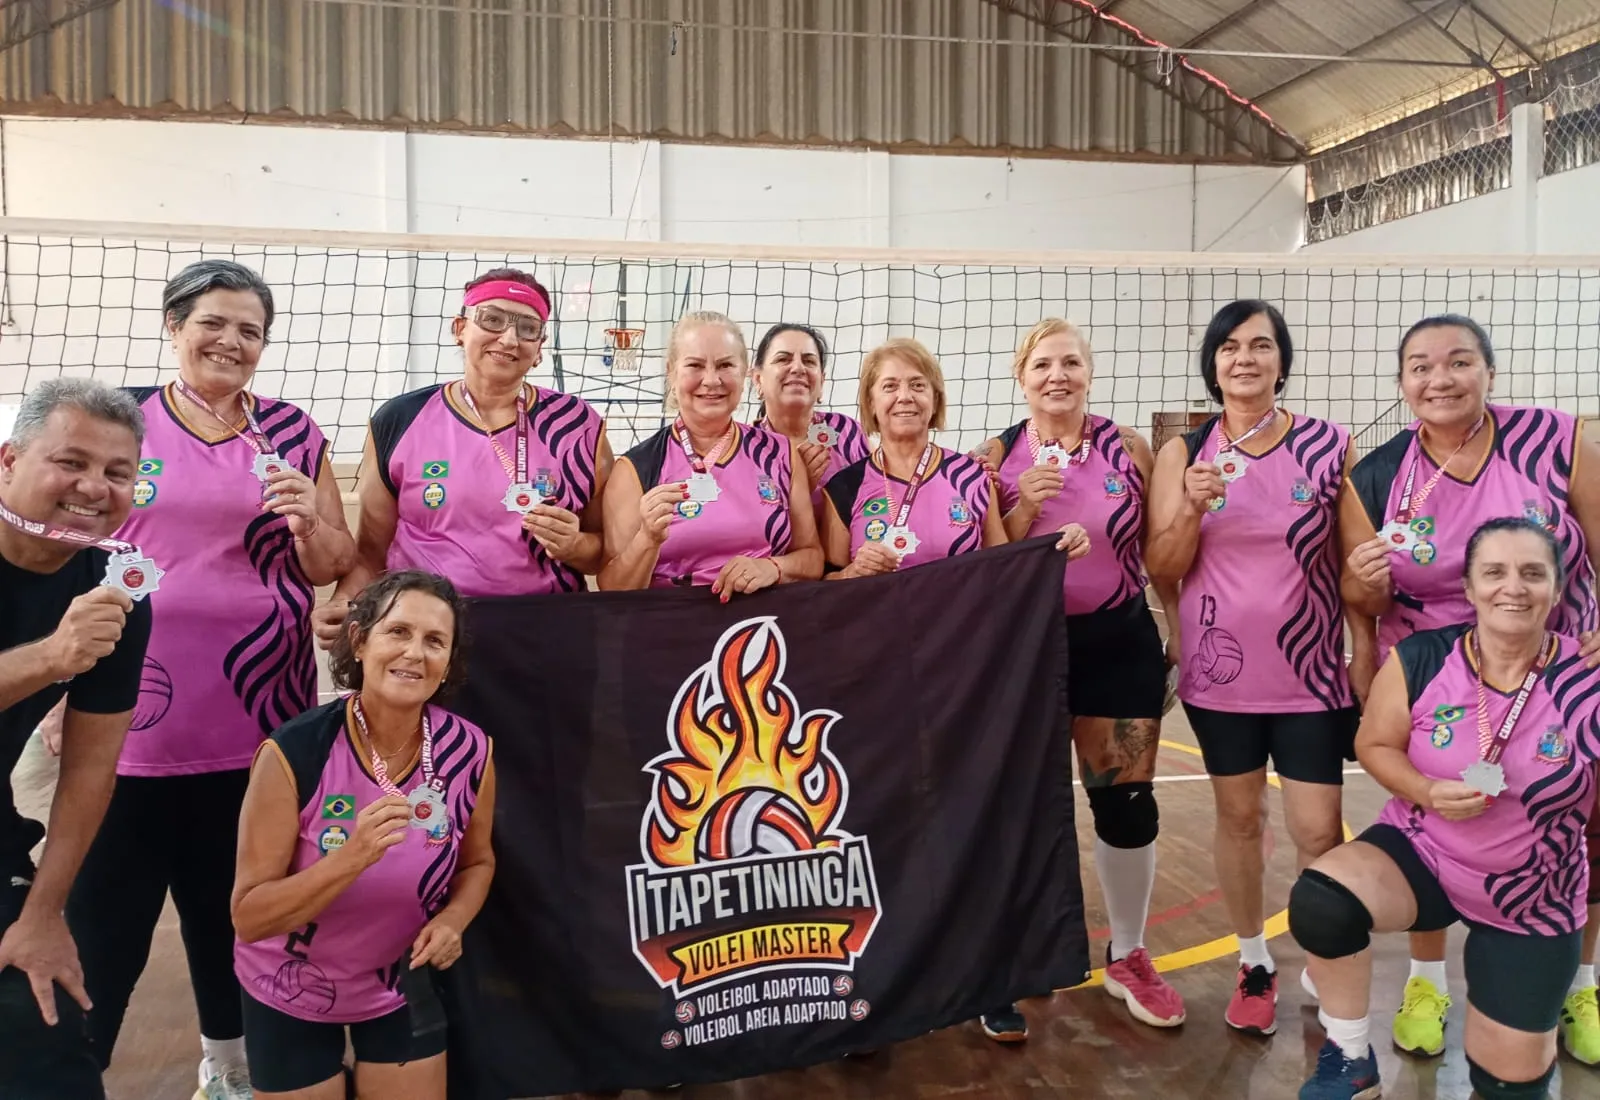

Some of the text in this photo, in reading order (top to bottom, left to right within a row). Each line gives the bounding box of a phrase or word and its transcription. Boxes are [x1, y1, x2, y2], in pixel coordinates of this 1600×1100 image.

[1200, 594, 1216, 627] 13
[1498, 689, 1530, 740] CAMPEONATO
[422, 715, 434, 772] CAMPEONATO
[635, 846, 872, 942] ITAPETININGA
[688, 926, 832, 976] VOLEI MASTER
[697, 976, 830, 1017] VOLEIBOL ADAPTADO
[684, 1000, 847, 1047] VOLEIBOL AREIA ADAPTADO
